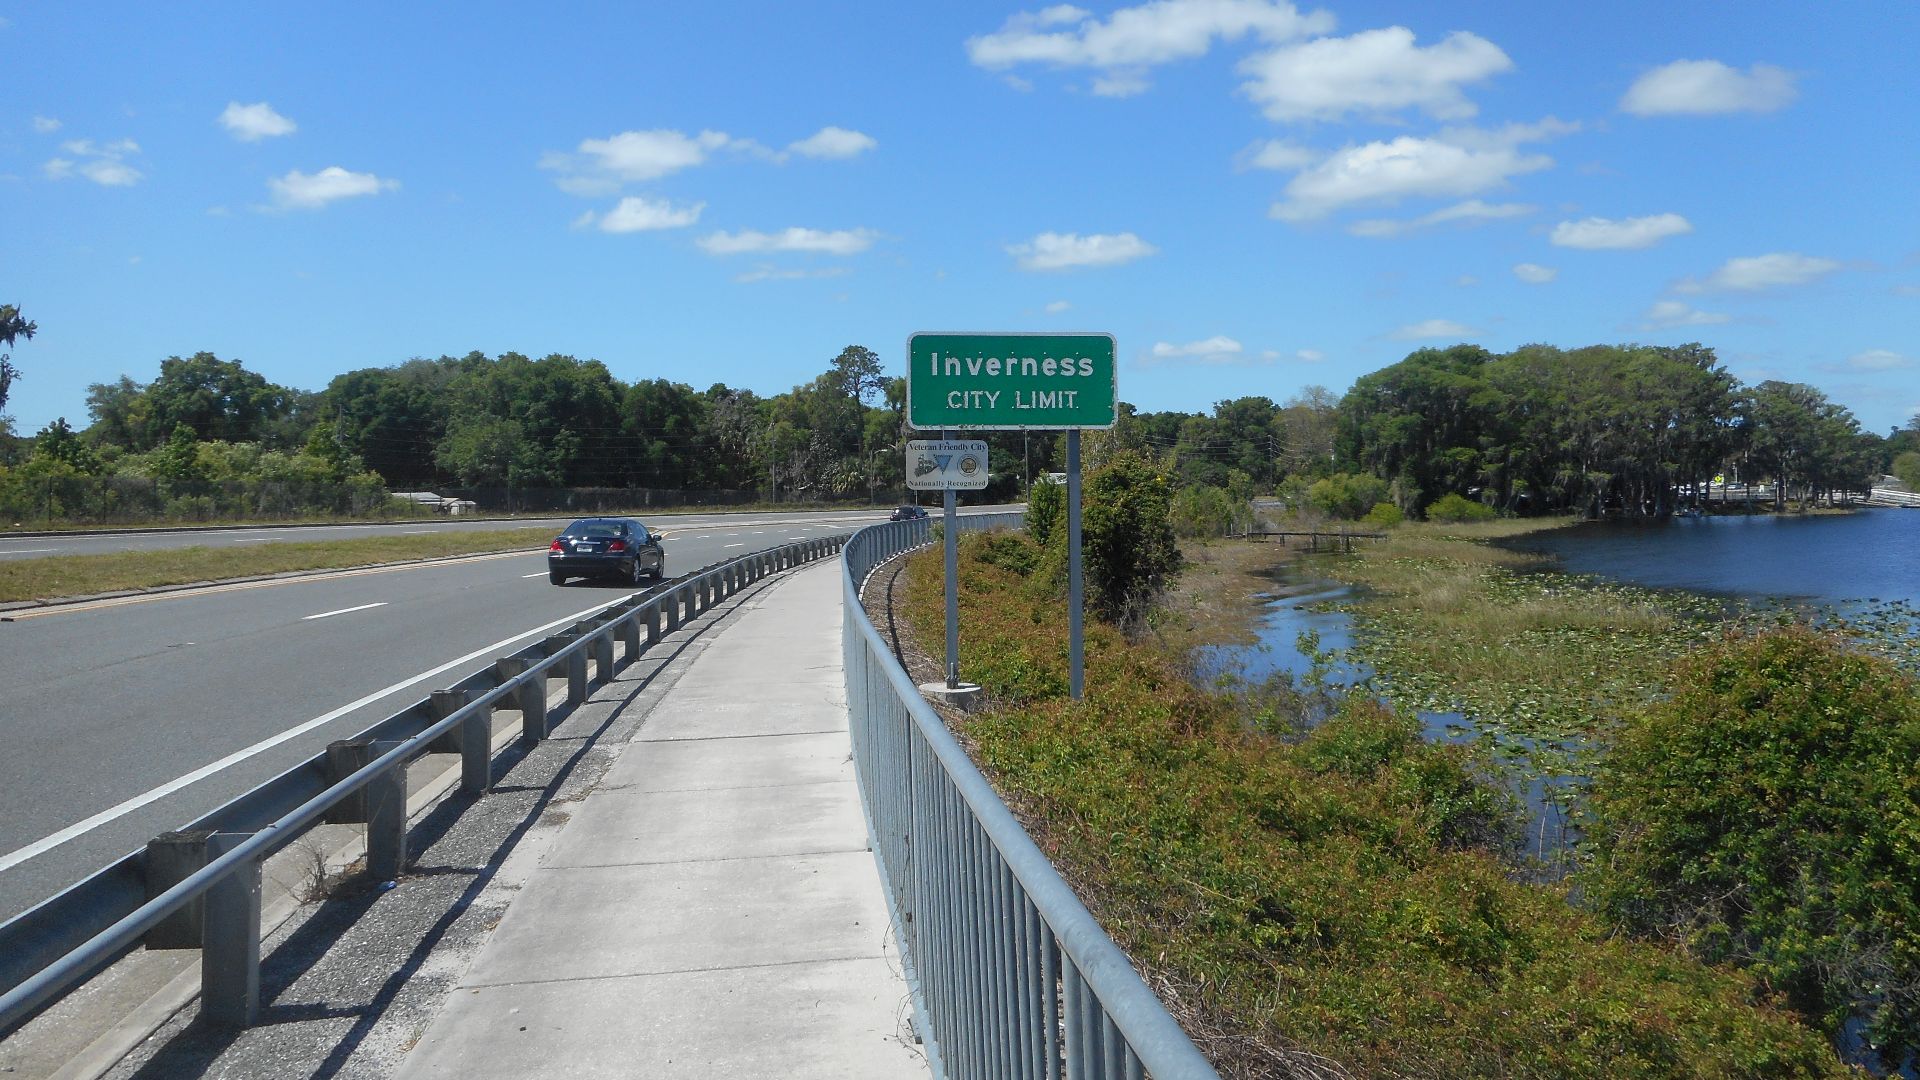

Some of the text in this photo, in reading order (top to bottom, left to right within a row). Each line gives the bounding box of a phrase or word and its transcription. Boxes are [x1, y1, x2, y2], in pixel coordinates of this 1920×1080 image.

[931, 352, 1094, 376] Inverness
[947, 390, 1078, 409] CITY LIMIT
[909, 443, 986, 452] Veteran Friendly City
